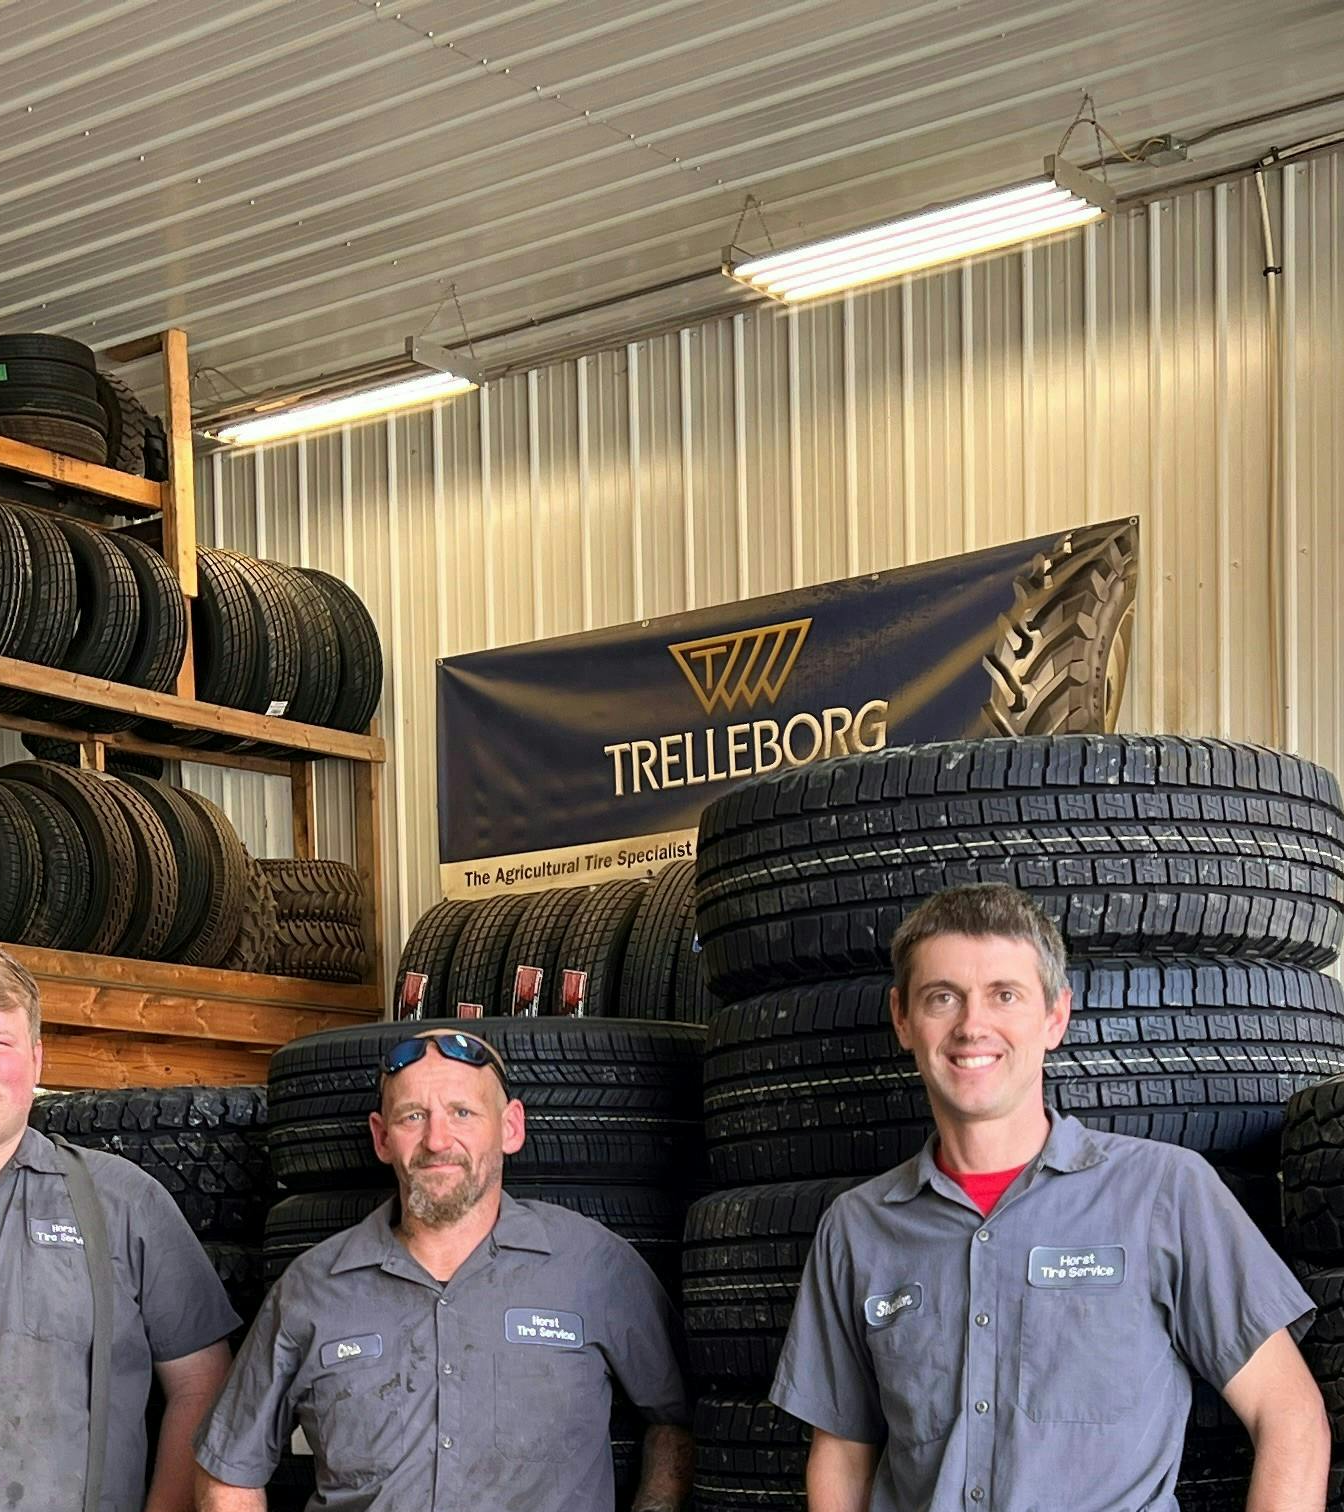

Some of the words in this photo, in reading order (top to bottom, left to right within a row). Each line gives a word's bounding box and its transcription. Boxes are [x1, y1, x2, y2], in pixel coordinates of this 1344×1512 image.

[604, 699, 889, 796] TRELLEBORG
[464, 871, 491, 887] The
[495, 856, 580, 885] Agricultural
[585, 854, 612, 871] Tire
[617, 840, 693, 871] Specialist
[51, 1224, 77, 1234] Horst
[60, 1232, 85, 1245] Servi
[1059, 1253, 1096, 1267] Horst
[1041, 1265, 1067, 1279] Tire
[1069, 1264, 1115, 1278] Service
[531, 1314, 560, 1329] Horst
[517, 1324, 537, 1337] Tire
[539, 1325, 576, 1341] Service
